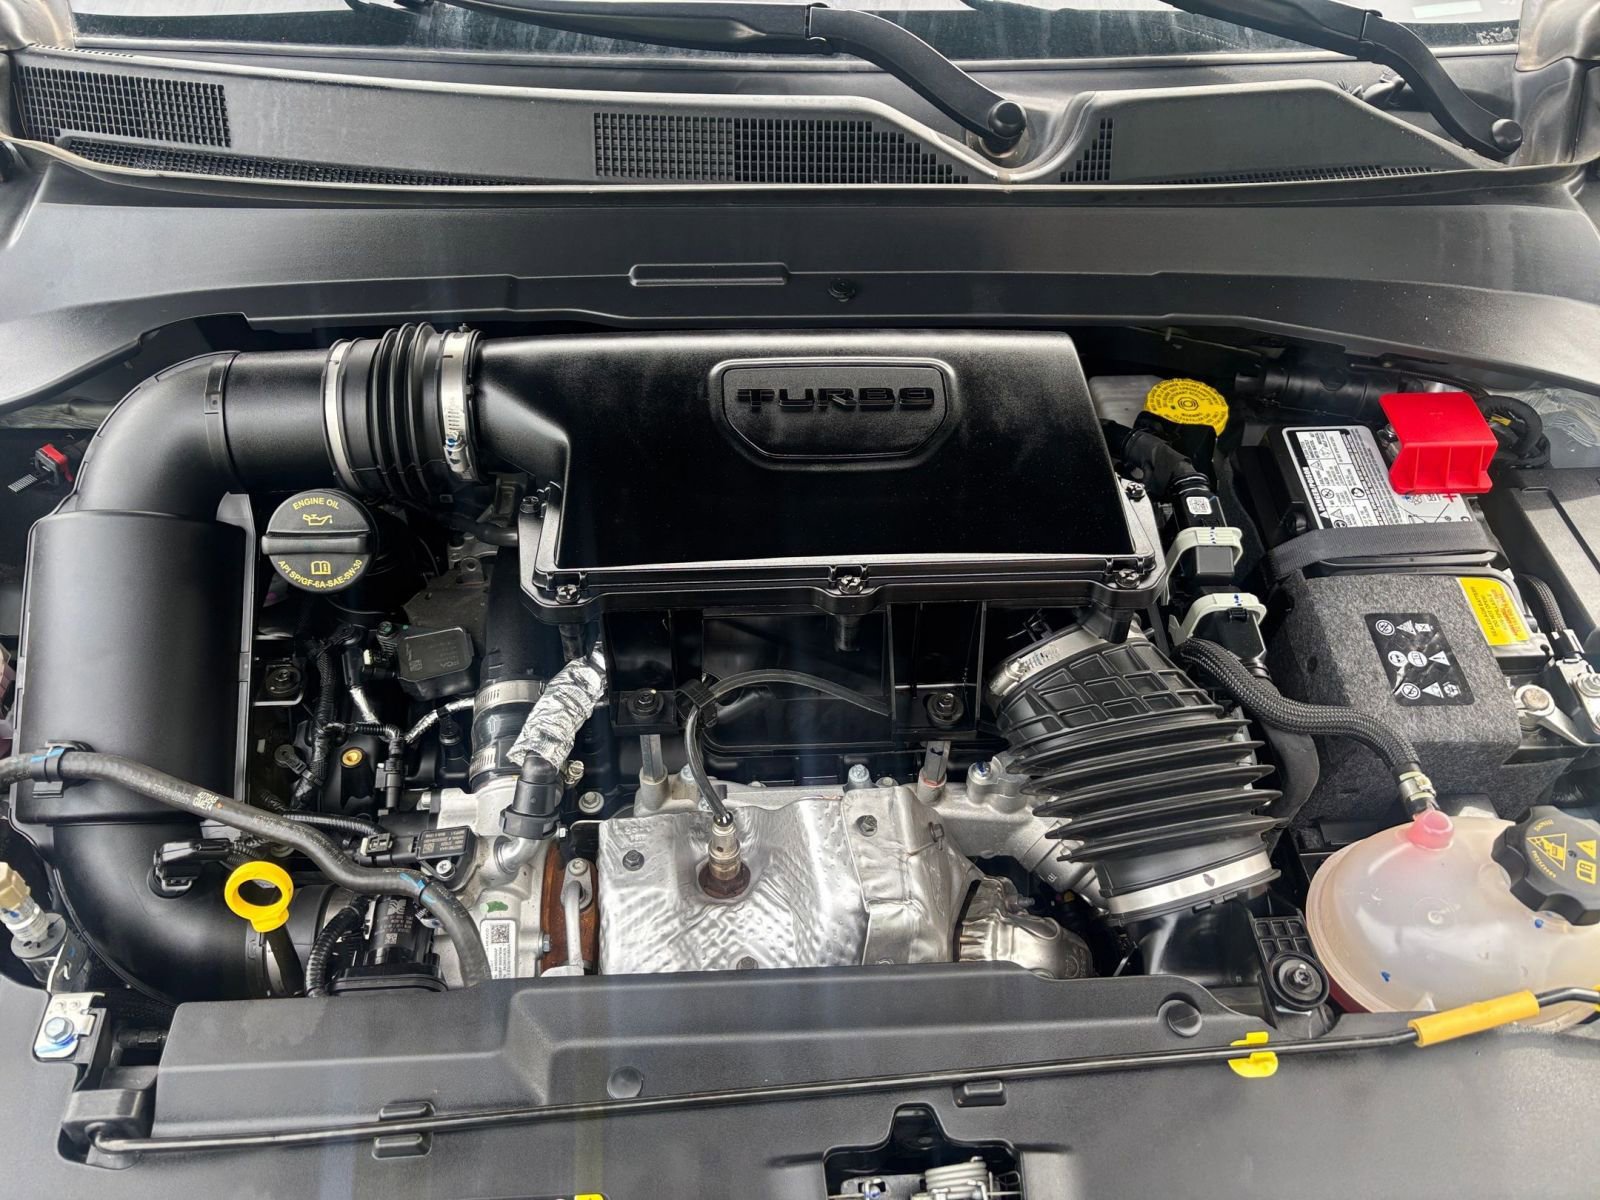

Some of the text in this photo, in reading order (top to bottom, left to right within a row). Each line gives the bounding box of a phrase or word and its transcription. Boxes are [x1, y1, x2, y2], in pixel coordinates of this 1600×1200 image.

[738, 387, 935, 411] TURBO
[292, 497, 340, 511] ENGINE OIL
[277, 560, 292, 574] API
